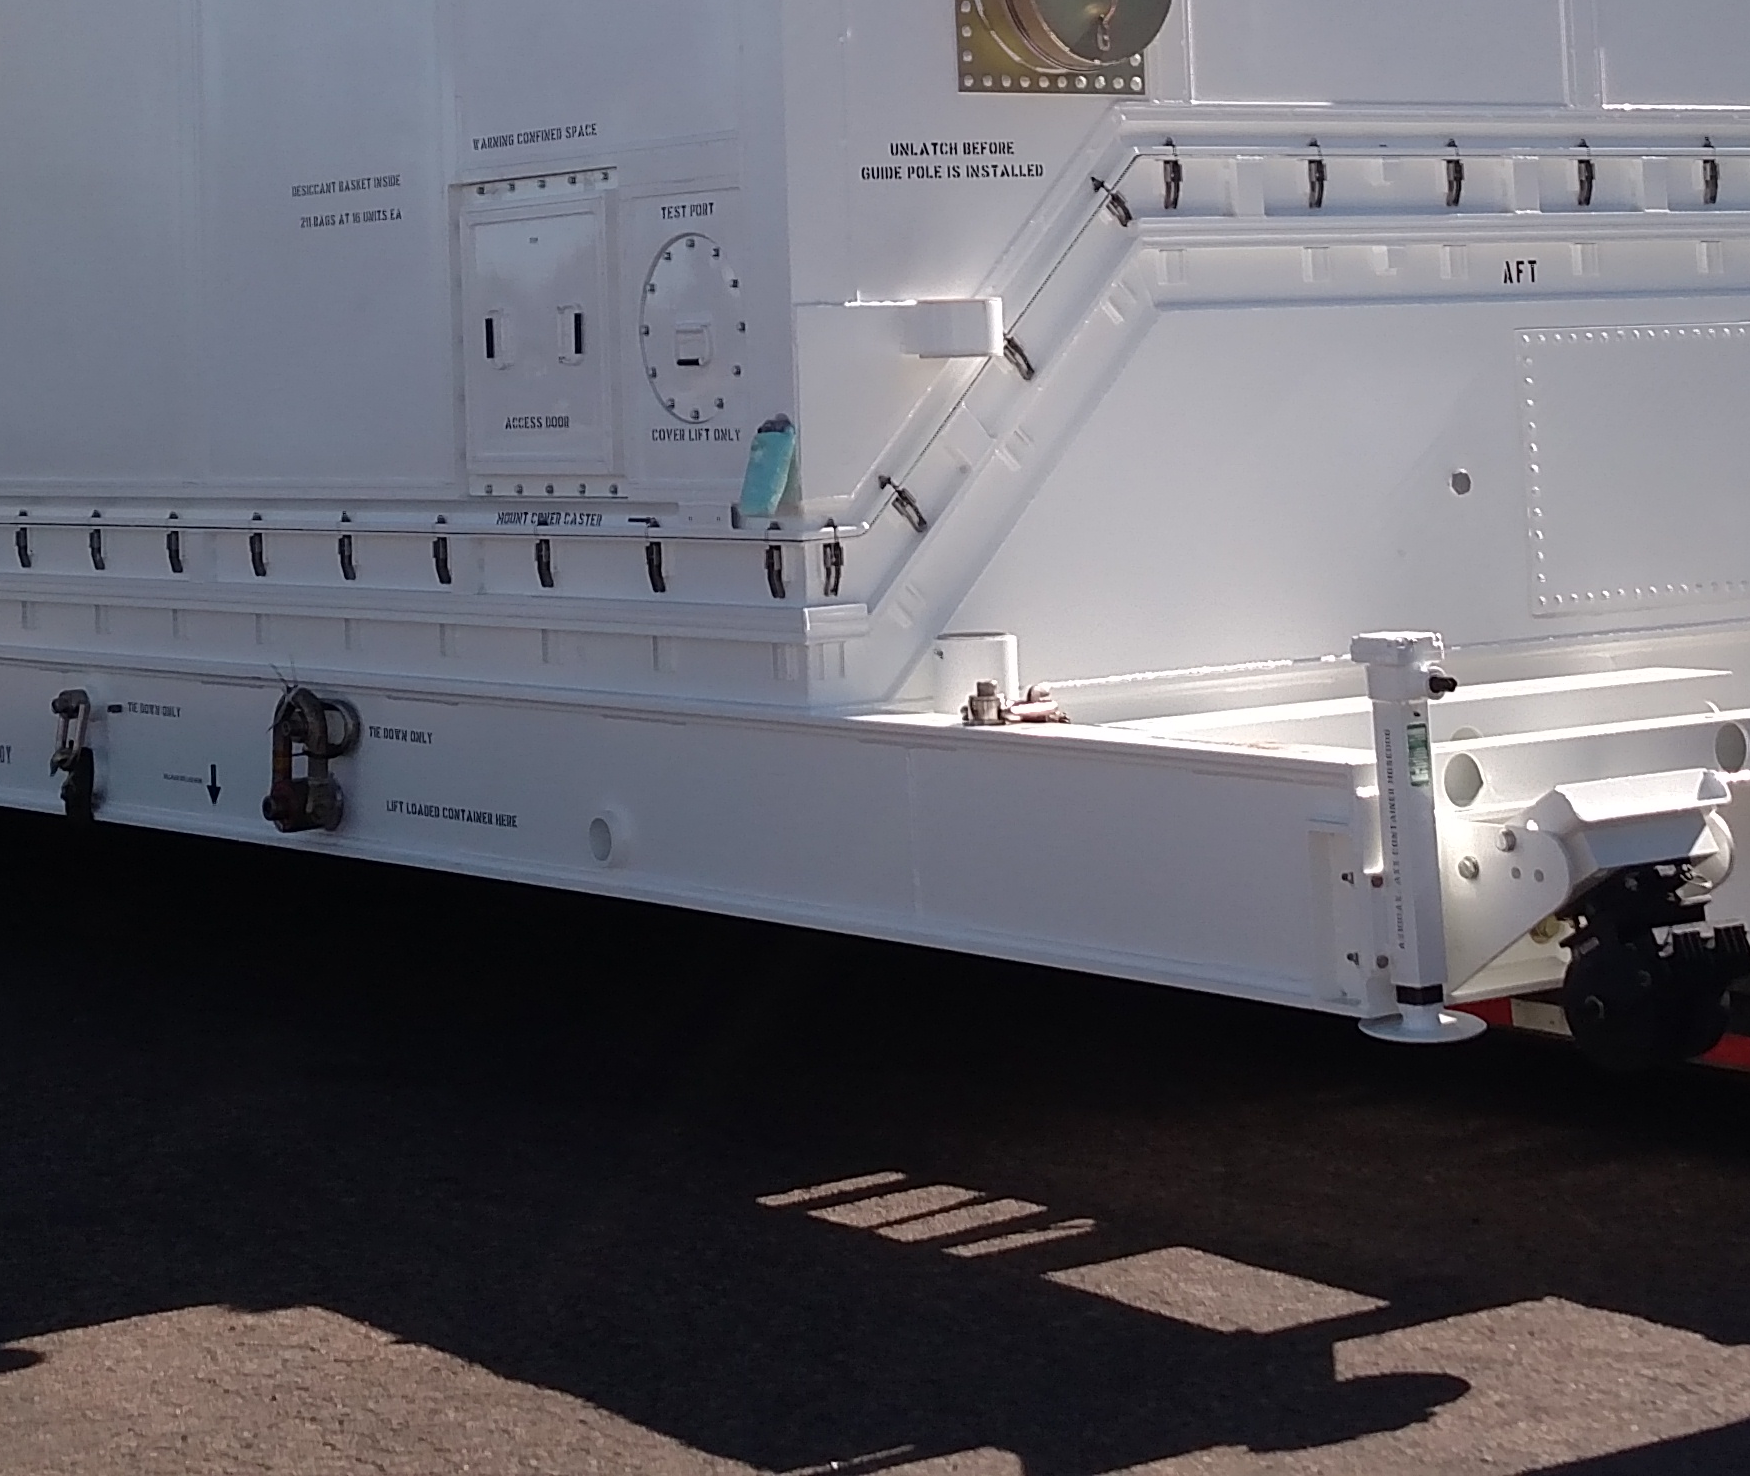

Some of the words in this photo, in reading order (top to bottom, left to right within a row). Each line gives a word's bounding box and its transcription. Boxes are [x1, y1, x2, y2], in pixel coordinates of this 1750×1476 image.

[473, 134, 514, 151] WARNING
[517, 127, 562, 145] CONFINED
[565, 123, 598, 139] SPACE
[890, 142, 958, 156] UNLATCH
[962, 141, 1015, 155] BEFORE
[861, 166, 902, 180] GUIDE
[907, 165, 942, 179] POLE
[947, 165, 961, 179] IS
[966, 163, 1044, 178] INSTALLED
[292, 181, 336, 198] DESICCANT
[338, 177, 371, 193] BASKET
[373, 174, 401, 189] INSIDE
[338, 212, 350, 225] AT
[363, 209, 388, 222] UNITS
[390, 208, 402, 221] EA
[661, 205, 686, 220] TEST
[690, 202, 714, 217] PORT
[1503, 260, 1538, 284] AFT
[505, 416, 543, 430] ACCESS
[545, 415, 570, 428] DOOR
[651, 428, 685, 441] COVER
[688, 428, 710, 441] LIFT
[713, 428, 741, 441] ONLY
[496, 512, 529, 525] MOUNT
[563, 512, 602, 526] CASTER
[369, 726, 381, 738] TIE
[383, 727, 408, 742] DOWN
[410, 730, 433, 744] ONLY
[386, 800, 404, 813] LIFT
[406, 802, 440, 818] LOADED
[442, 806, 493, 825] CONTAINER
[495, 814, 518, 828] HERE
